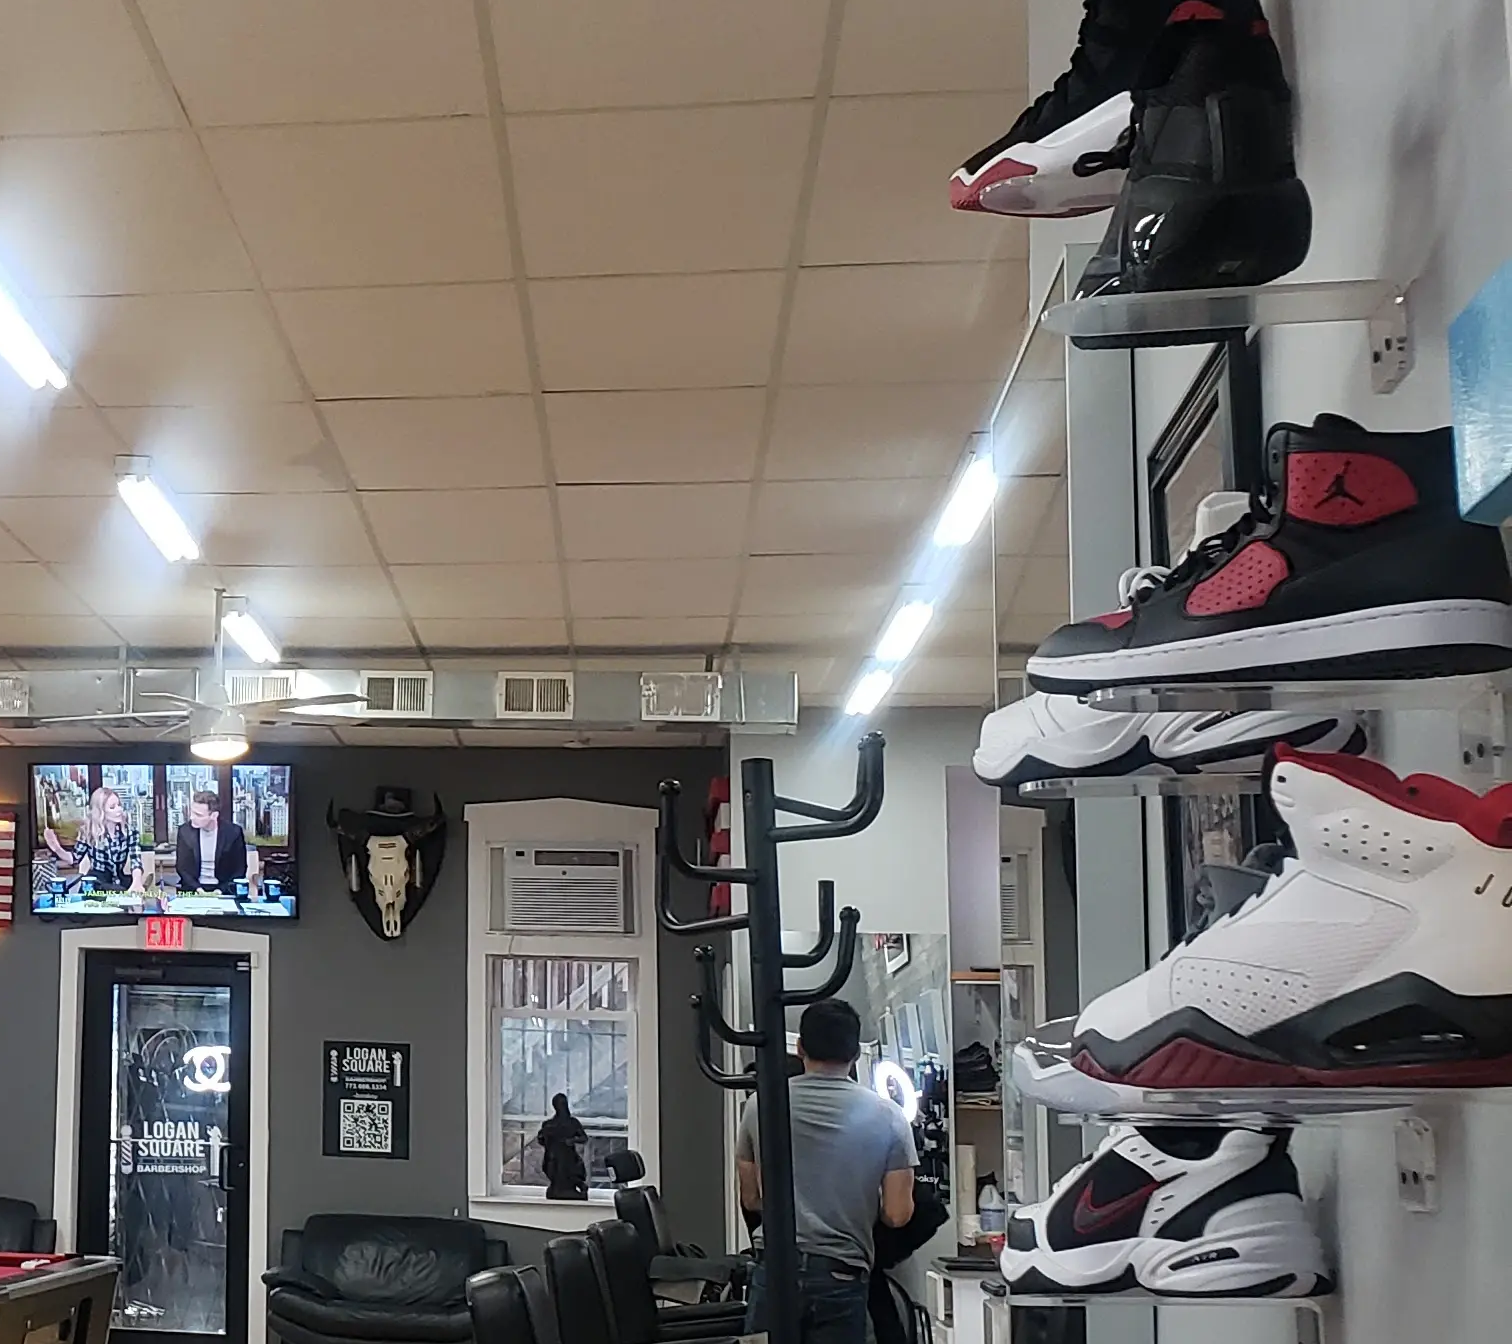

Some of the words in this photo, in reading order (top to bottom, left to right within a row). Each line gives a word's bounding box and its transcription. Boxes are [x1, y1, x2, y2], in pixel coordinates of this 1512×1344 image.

[146, 917, 185, 948] EXIT
[346, 1047, 387, 1060] LOGAN
[342, 1059, 391, 1073] SQUARE
[143, 1121, 199, 1139] LOGAN
[138, 1140, 206, 1157] SQUARE
[137, 1165, 207, 1173] BARBERSHOP
